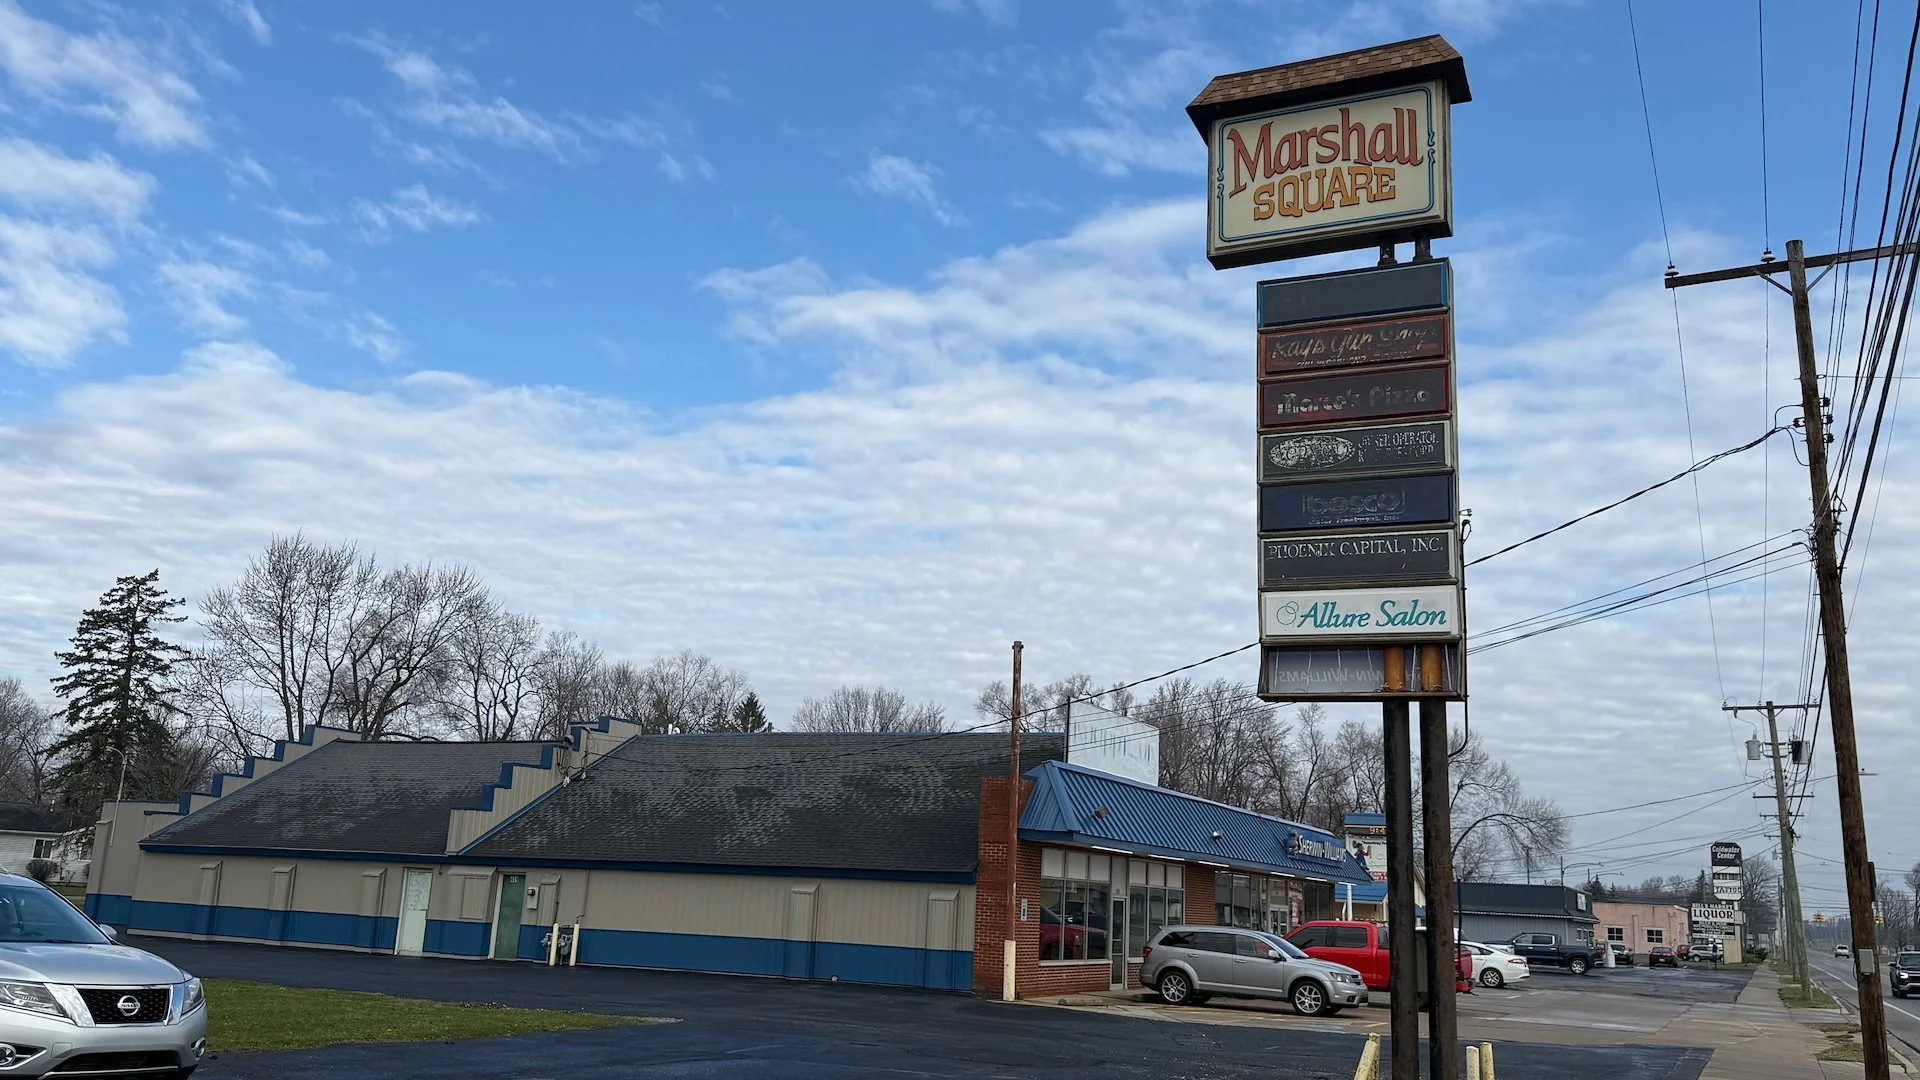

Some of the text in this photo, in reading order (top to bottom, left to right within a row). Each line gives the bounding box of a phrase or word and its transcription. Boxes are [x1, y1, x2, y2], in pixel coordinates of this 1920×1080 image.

[1227, 108, 1423, 198] Marshall
[1254, 166, 1396, 220] SQUARE
[1267, 544, 1335, 560] PHOENIX
[1340, 539, 1407, 556] CAPITAL,
[1297, 599, 1447, 628] Allure Salon
[1298, 834, 1347, 862] SHERWIN-WILLIAMS
[1693, 909, 1734, 920] LIQUOR
